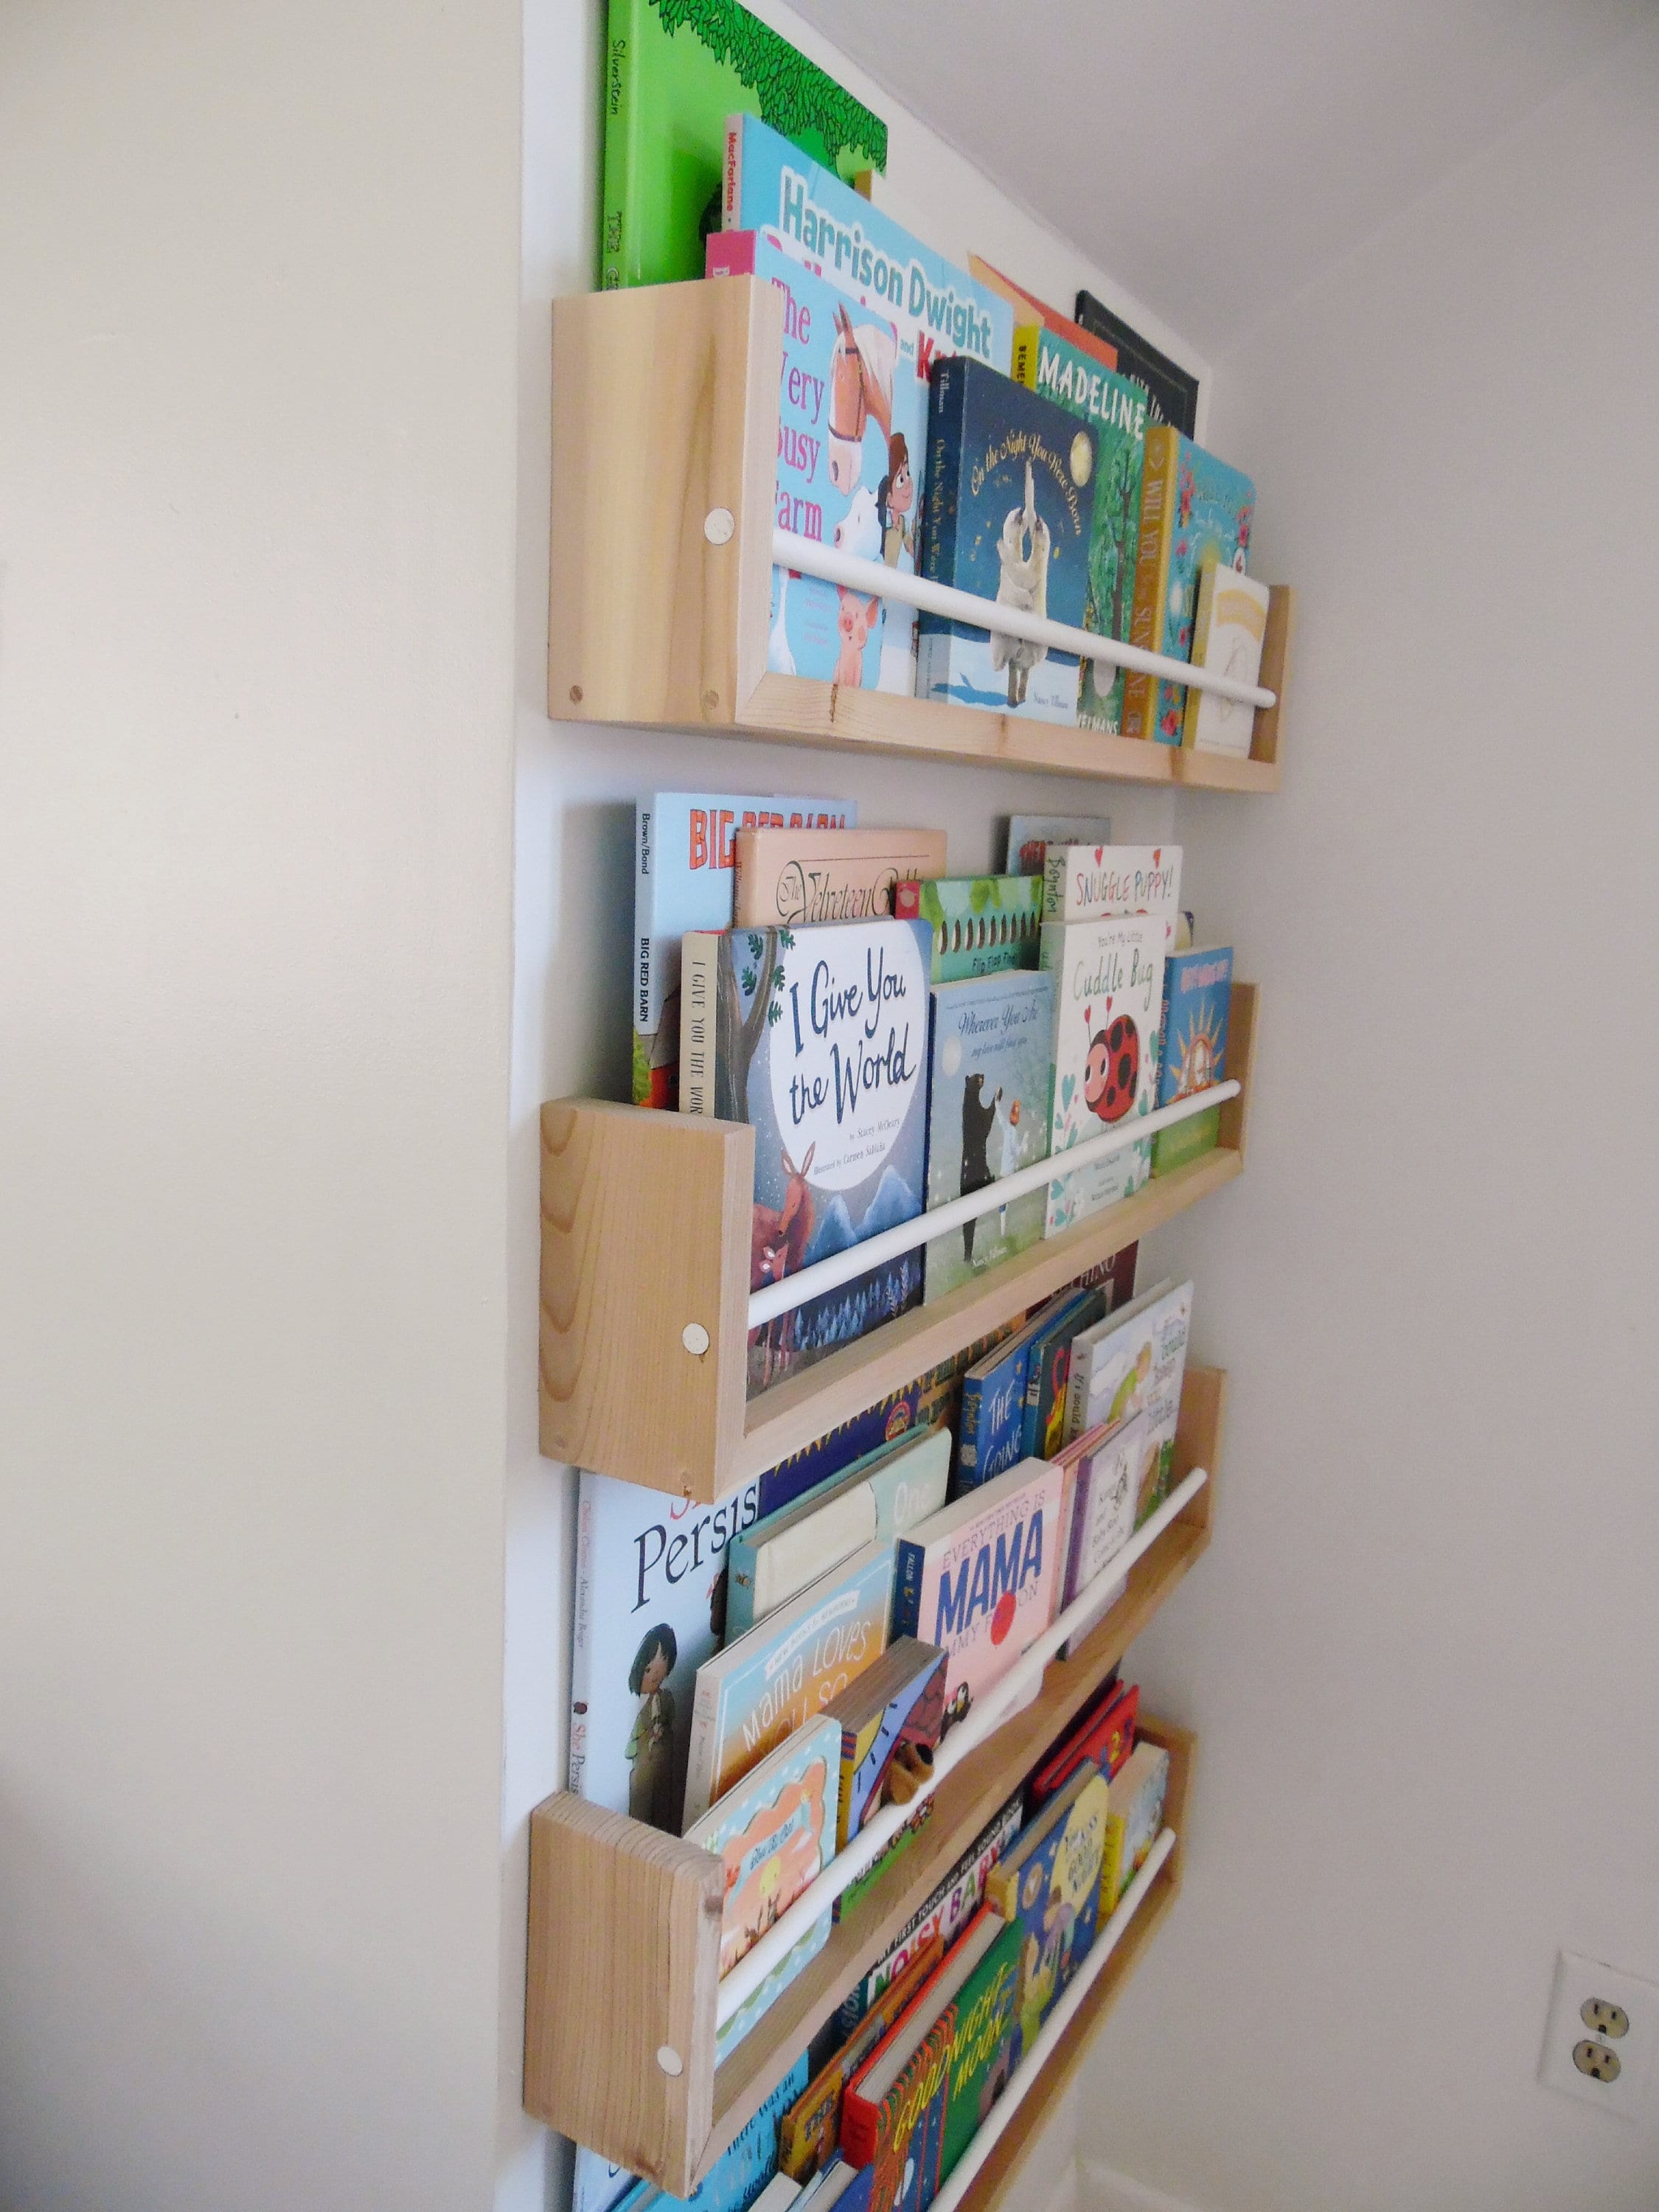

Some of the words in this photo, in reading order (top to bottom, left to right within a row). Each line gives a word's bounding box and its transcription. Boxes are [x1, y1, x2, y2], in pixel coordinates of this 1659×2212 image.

[726, 131, 737, 212] MacFarlane
[783, 176, 904, 307] Harrison
[908, 265, 991, 359] Dwight
[781, 351, 824, 425] ery
[939, 369, 950, 414] Tillman
[1037, 347, 1146, 441] MADELINE
[775, 479, 822, 543] arm
[641, 813, 650, 875] Brown/Bond
[1046, 856, 1066, 914] Boynton
[1076, 872, 1130, 907] SNUGGLE
[1134, 865, 1174, 902] PUPPY!
[640, 962, 649, 987] RED
[641, 938, 650, 959] BIG
[1073, 952, 1124, 1001] Cuddle
[1129, 947, 1154, 1012] Bug
[639, 990, 649, 1022] BARN
[691, 971, 706, 1009] GIVE
[789, 981, 804, 1057] I
[810, 959, 863, 1038] Give
[864, 946, 907, 1039] You
[690, 1018, 705, 1046] YOU
[690, 1051, 704, 1078] THE
[789, 1074, 829, 1125] the
[830, 1022, 917, 1124] World
[988, 1380, 1015, 1436] THE
[942, 1499, 1029, 1570] EVERYTHING
[905, 1552, 917, 1581] FALLON
[934, 1509, 1043, 1648] MAMA
[742, 1655, 804, 1752] Mama
